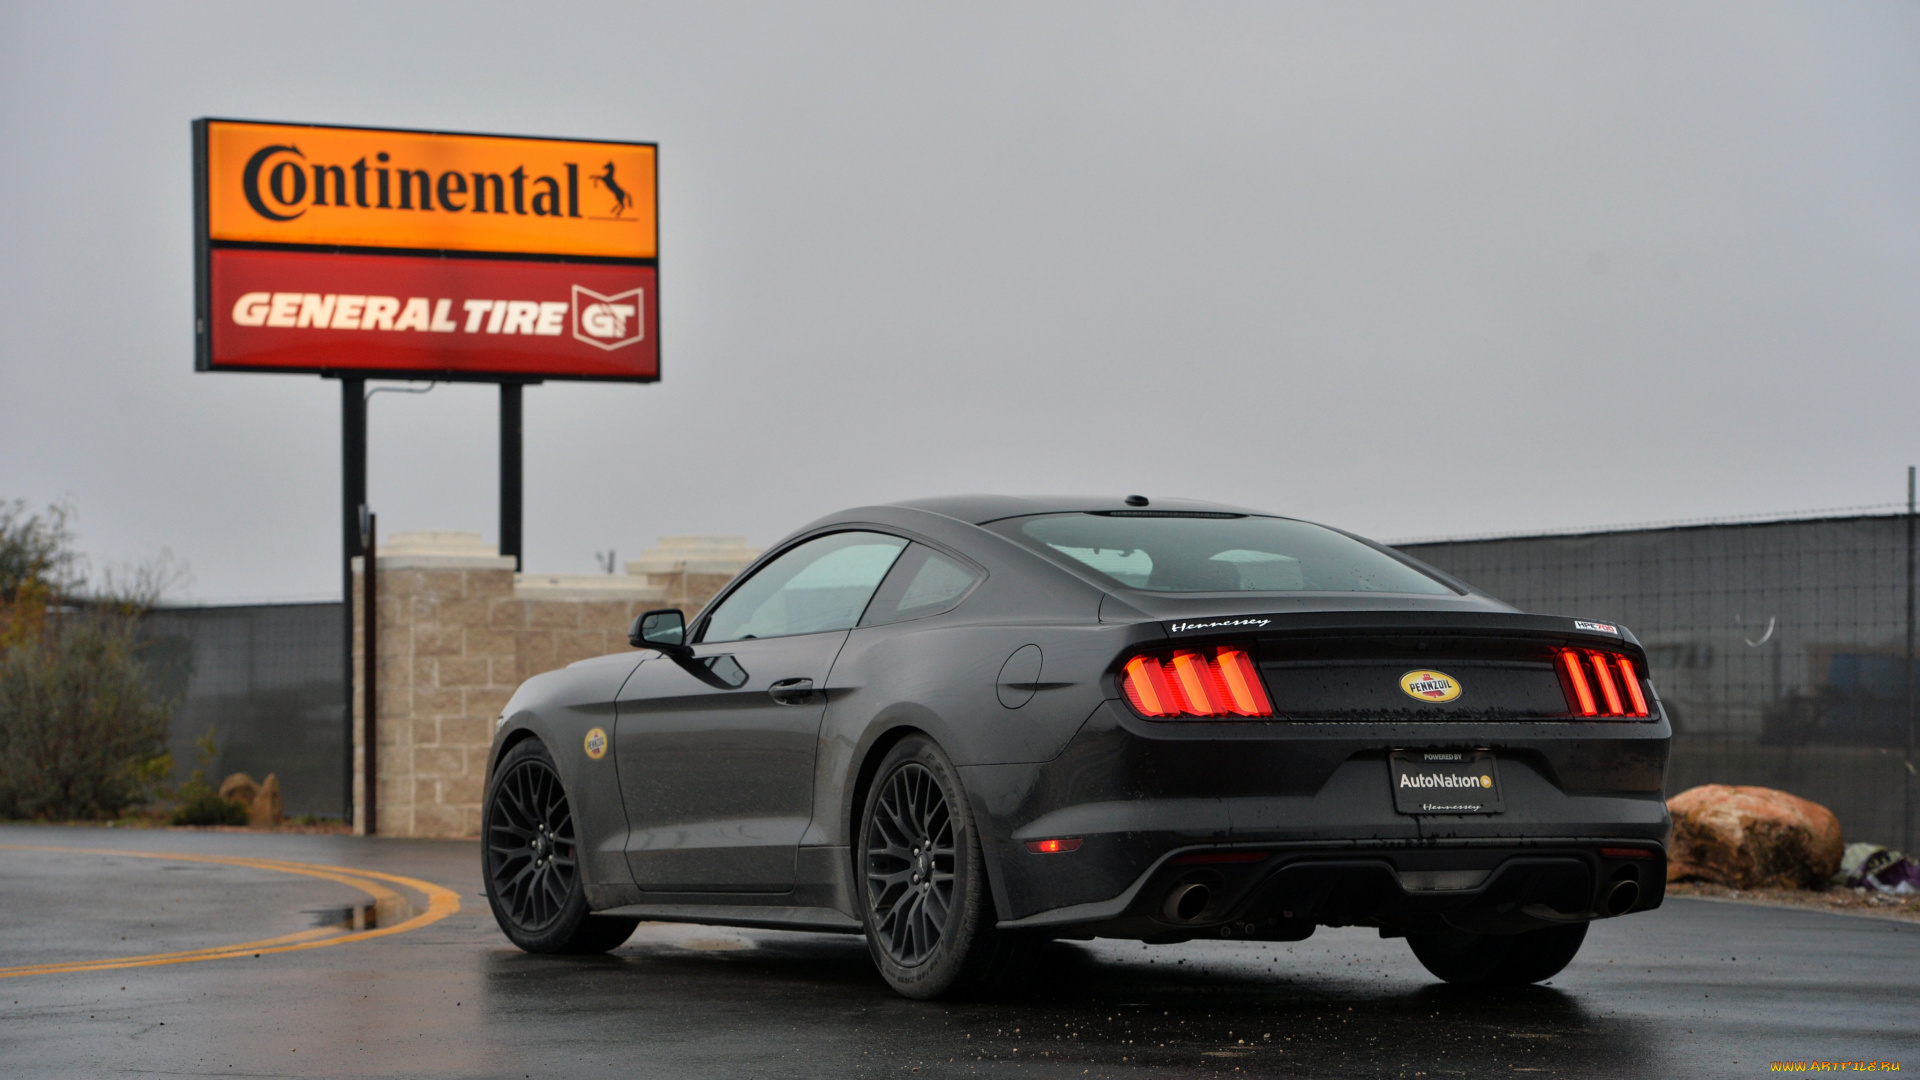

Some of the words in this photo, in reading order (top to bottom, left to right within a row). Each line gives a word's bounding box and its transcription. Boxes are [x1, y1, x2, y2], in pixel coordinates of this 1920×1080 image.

[242, 143, 583, 221] Continental
[232, 291, 459, 332] GENERAL
[463, 299, 568, 335] TIRE
[581, 303, 636, 338] GT
[1171, 619, 1271, 632] Hennessey
[1409, 679, 1452, 693] PENNZOIL
[1400, 773, 1480, 788] AutoNation
[1423, 803, 1481, 811] Hennessey
